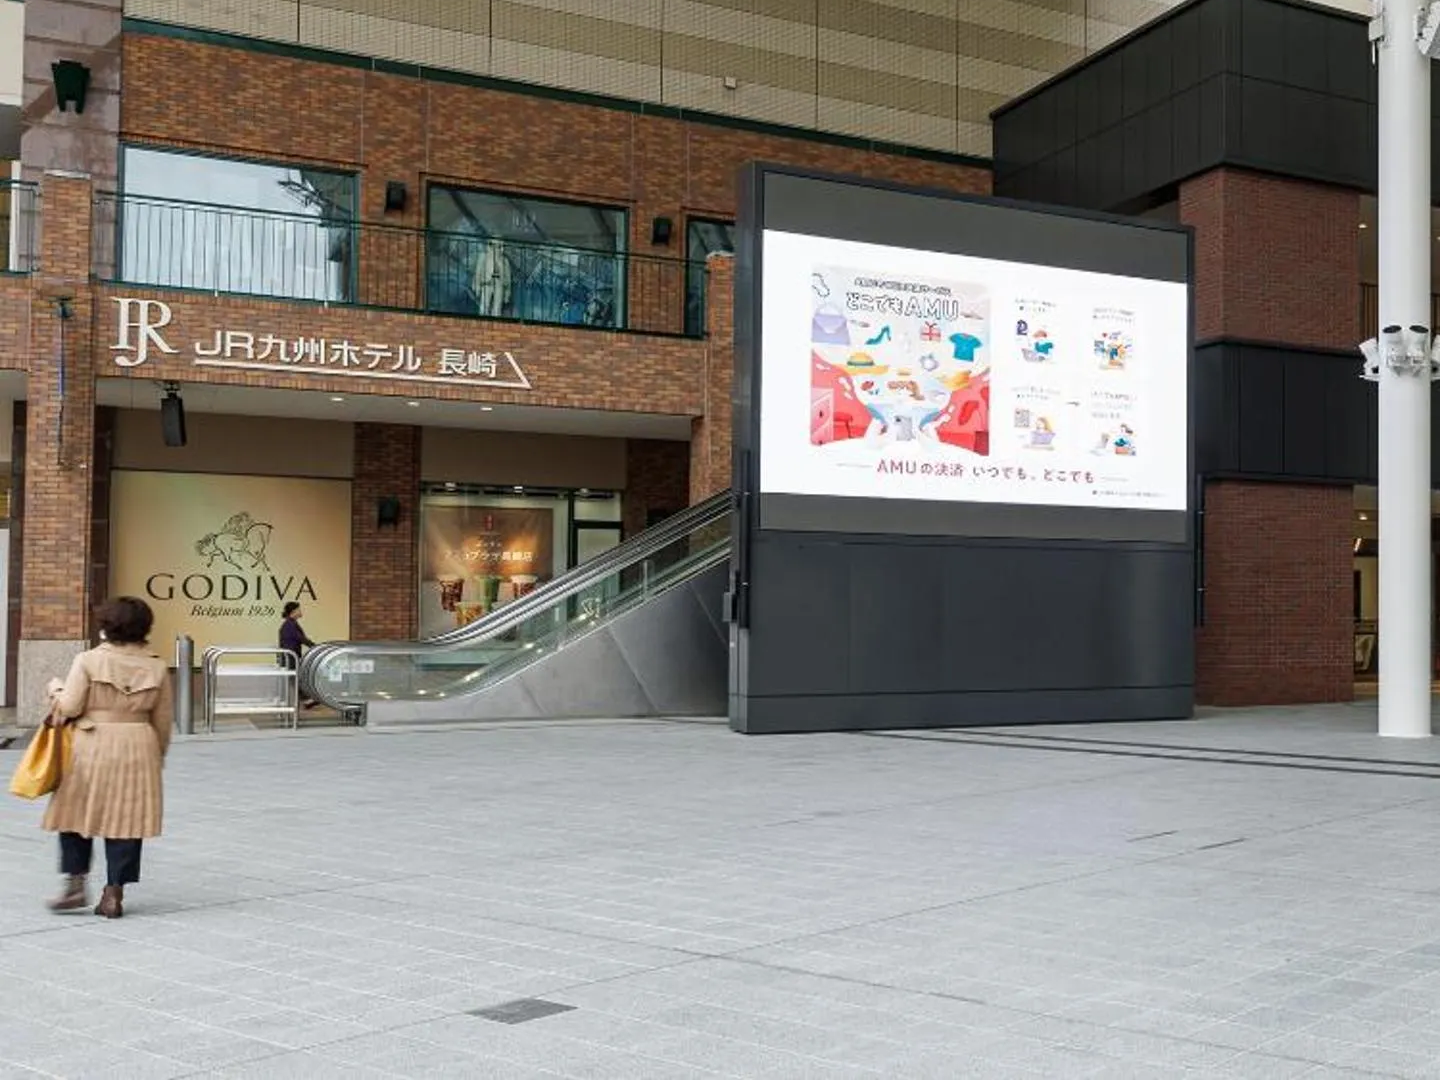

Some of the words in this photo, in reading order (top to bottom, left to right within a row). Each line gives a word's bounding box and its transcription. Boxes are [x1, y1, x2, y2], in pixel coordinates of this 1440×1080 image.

[194, 329, 421, 372] JR九州ホテル
[436, 349, 498, 379] 長崎
[876, 459, 965, 477] AMUの決済
[145, 573, 318, 601] GODIVA
[191, 604, 244, 618] Belgium
[248, 604, 276, 618] 1926
